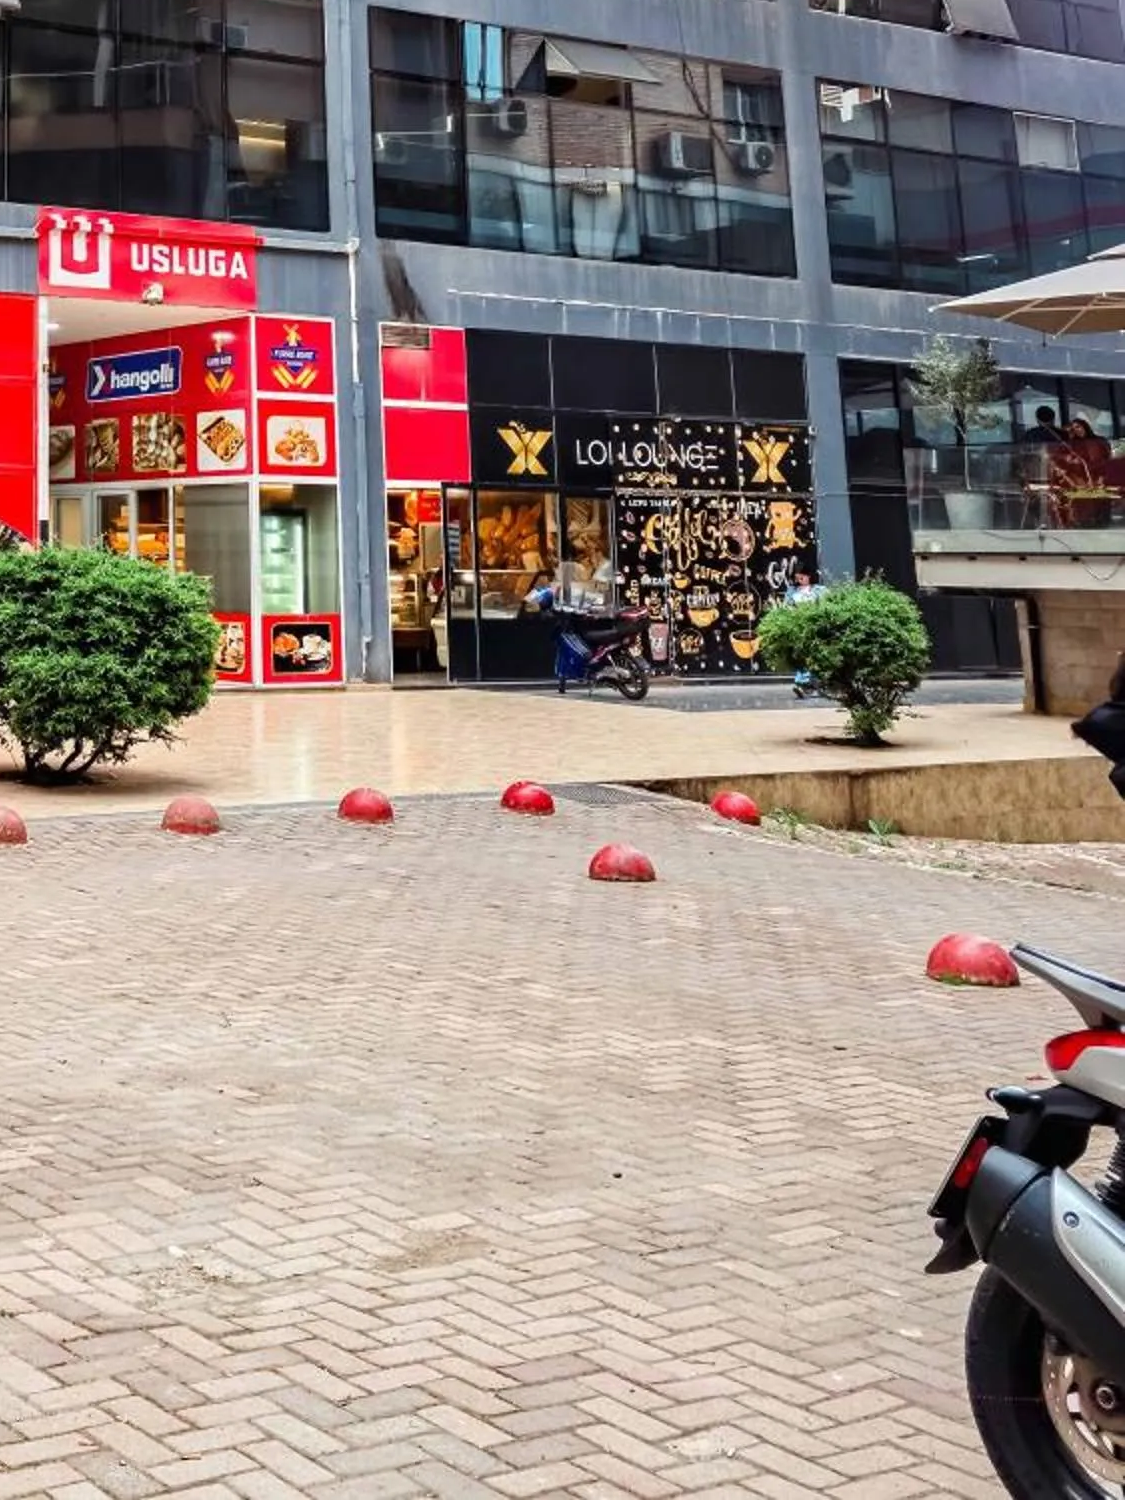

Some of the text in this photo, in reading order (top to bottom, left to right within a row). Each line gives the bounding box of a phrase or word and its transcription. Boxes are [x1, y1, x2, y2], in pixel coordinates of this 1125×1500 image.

[131, 242, 248, 279] USLUGA
[576, 439, 719, 469] LOI LOUNGE
